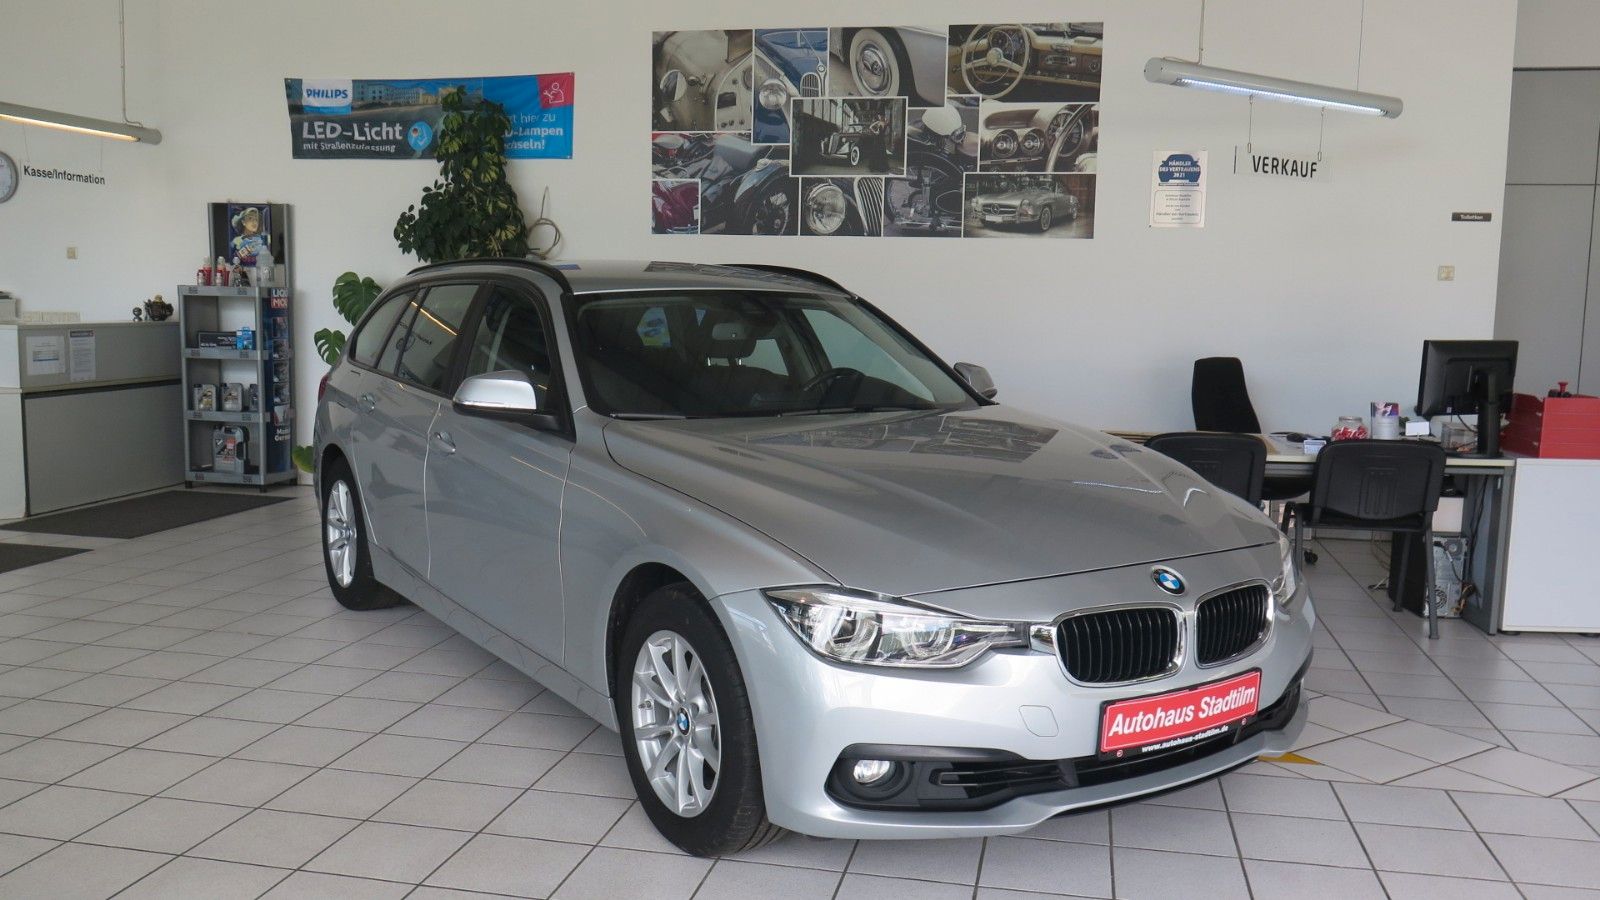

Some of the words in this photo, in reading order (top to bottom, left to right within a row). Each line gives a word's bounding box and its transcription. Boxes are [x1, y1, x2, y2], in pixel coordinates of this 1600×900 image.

[306, 88, 349, 99] PHILIPS
[542, 112, 556, 122] zu
[302, 121, 403, 141] LED-Licht
[303, 142, 318, 150] mit
[320, 141, 396, 153] Straßenzulassung
[1168, 159, 1192, 167] HÄNDLER
[1252, 154, 1318, 178] VERKAUF
[23, 165, 106, 185] Kasse/Information
[1109, 705, 1195, 737] Autohaus
[1198, 686, 1256, 718] Stadtilm
[1141, 725, 1230, 753] www.autohaus-stadtilm.de
